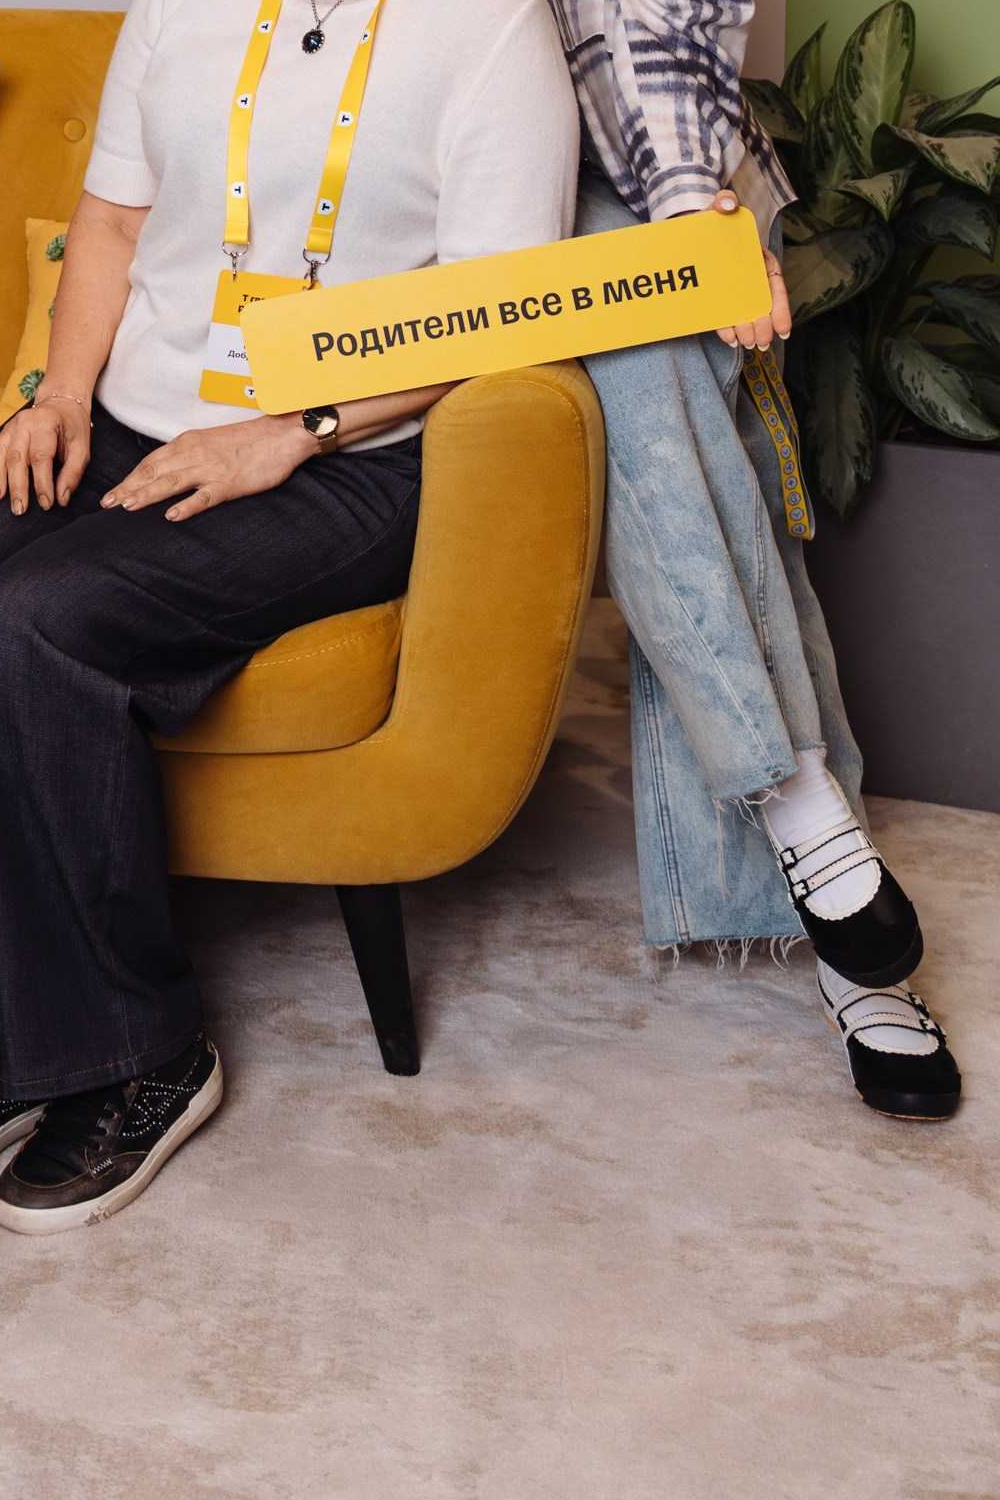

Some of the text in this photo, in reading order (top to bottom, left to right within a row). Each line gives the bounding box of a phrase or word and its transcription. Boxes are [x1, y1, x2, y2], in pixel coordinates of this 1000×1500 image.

[311, 264, 699, 362] Родители все в меня
[227, 349, 248, 361] Доб
